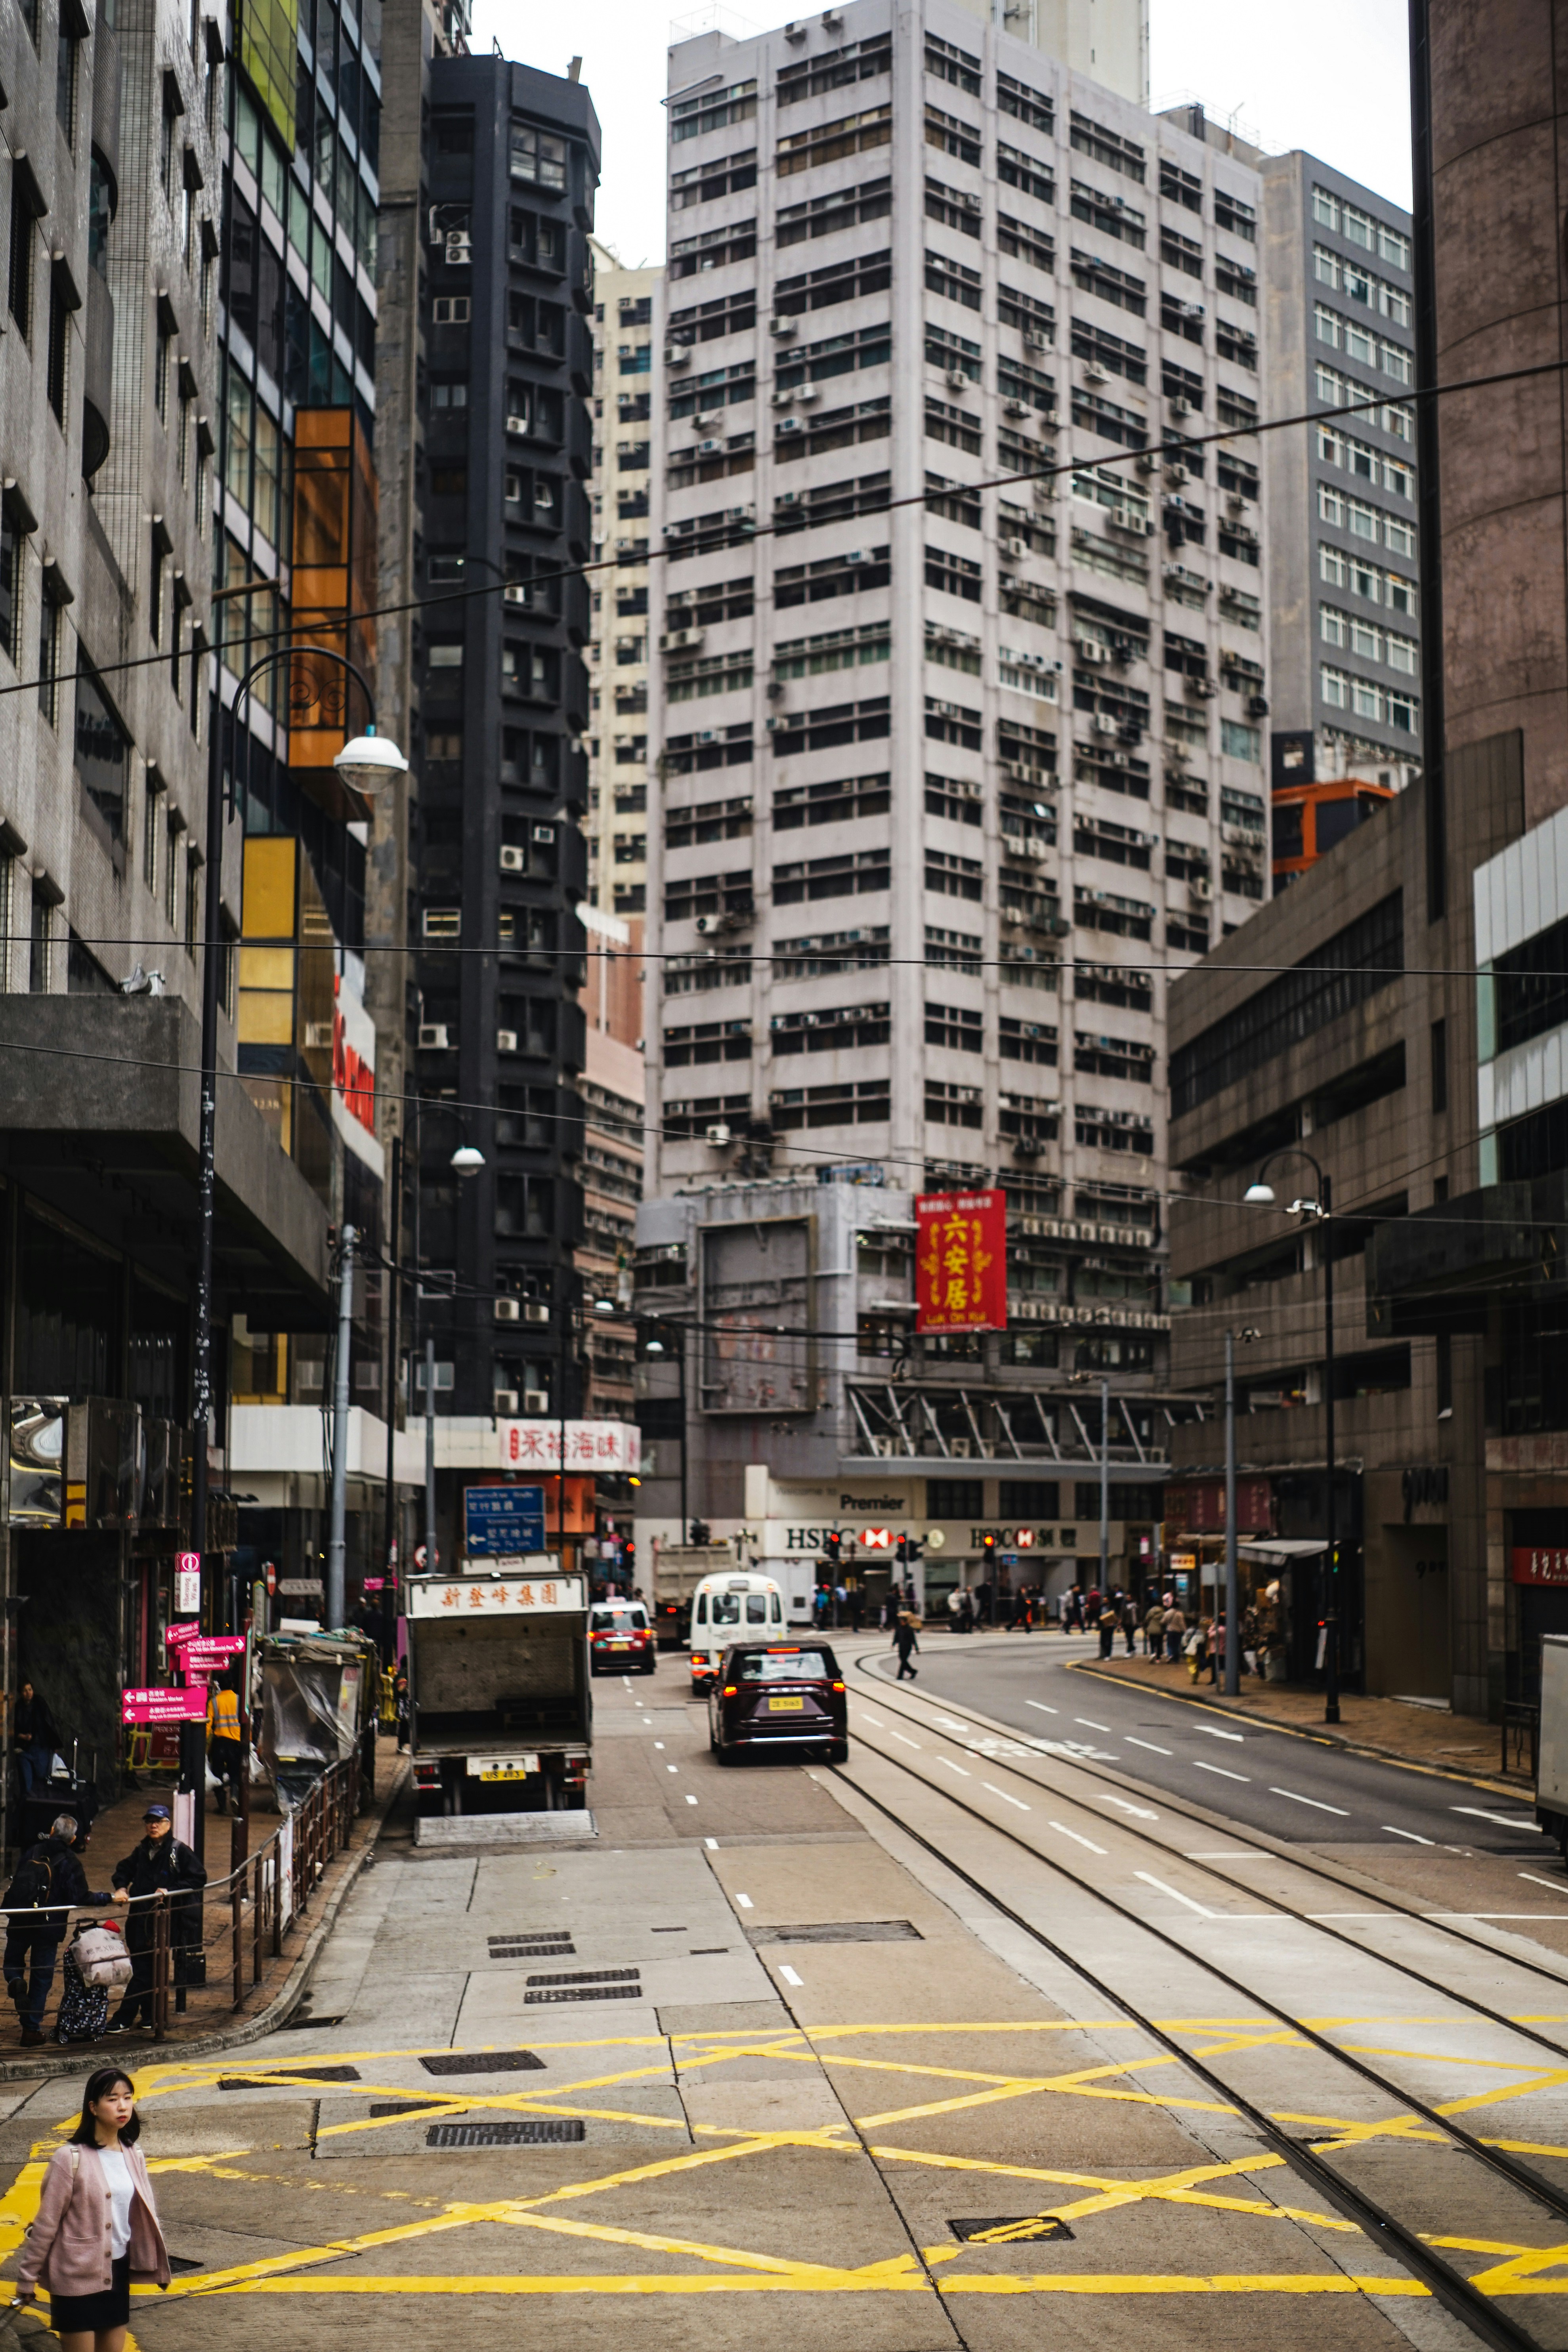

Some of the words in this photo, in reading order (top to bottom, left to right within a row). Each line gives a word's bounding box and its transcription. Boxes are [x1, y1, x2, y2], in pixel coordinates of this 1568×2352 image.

[943, 1212, 968, 1310] 六安居
[949, 1312, 965, 1323] On
[840, 1493, 905, 1510] Premier
[440, 1583, 557, 1608] 新登峰集團
